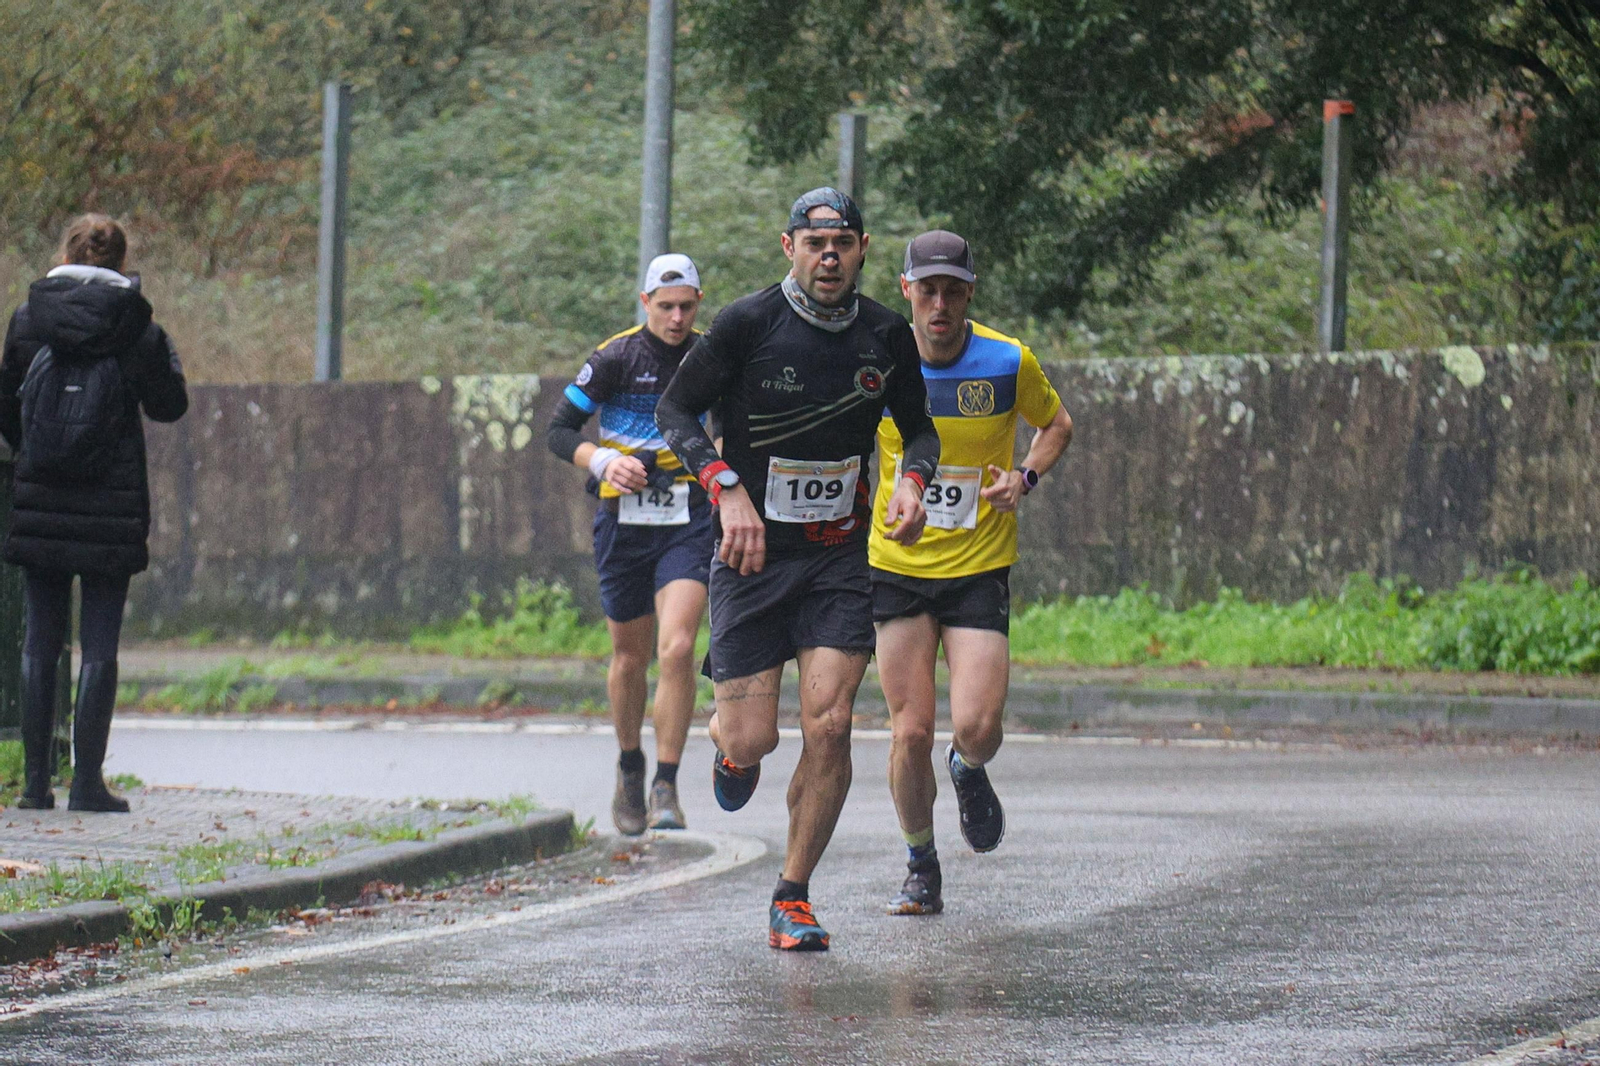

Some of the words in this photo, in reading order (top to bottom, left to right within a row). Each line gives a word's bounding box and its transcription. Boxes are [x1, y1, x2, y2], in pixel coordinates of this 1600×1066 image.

[773, 380, 805, 393] Trigal
[635, 490, 675, 507] 142
[787, 478, 844, 501] 109
[926, 483, 962, 507] 39
